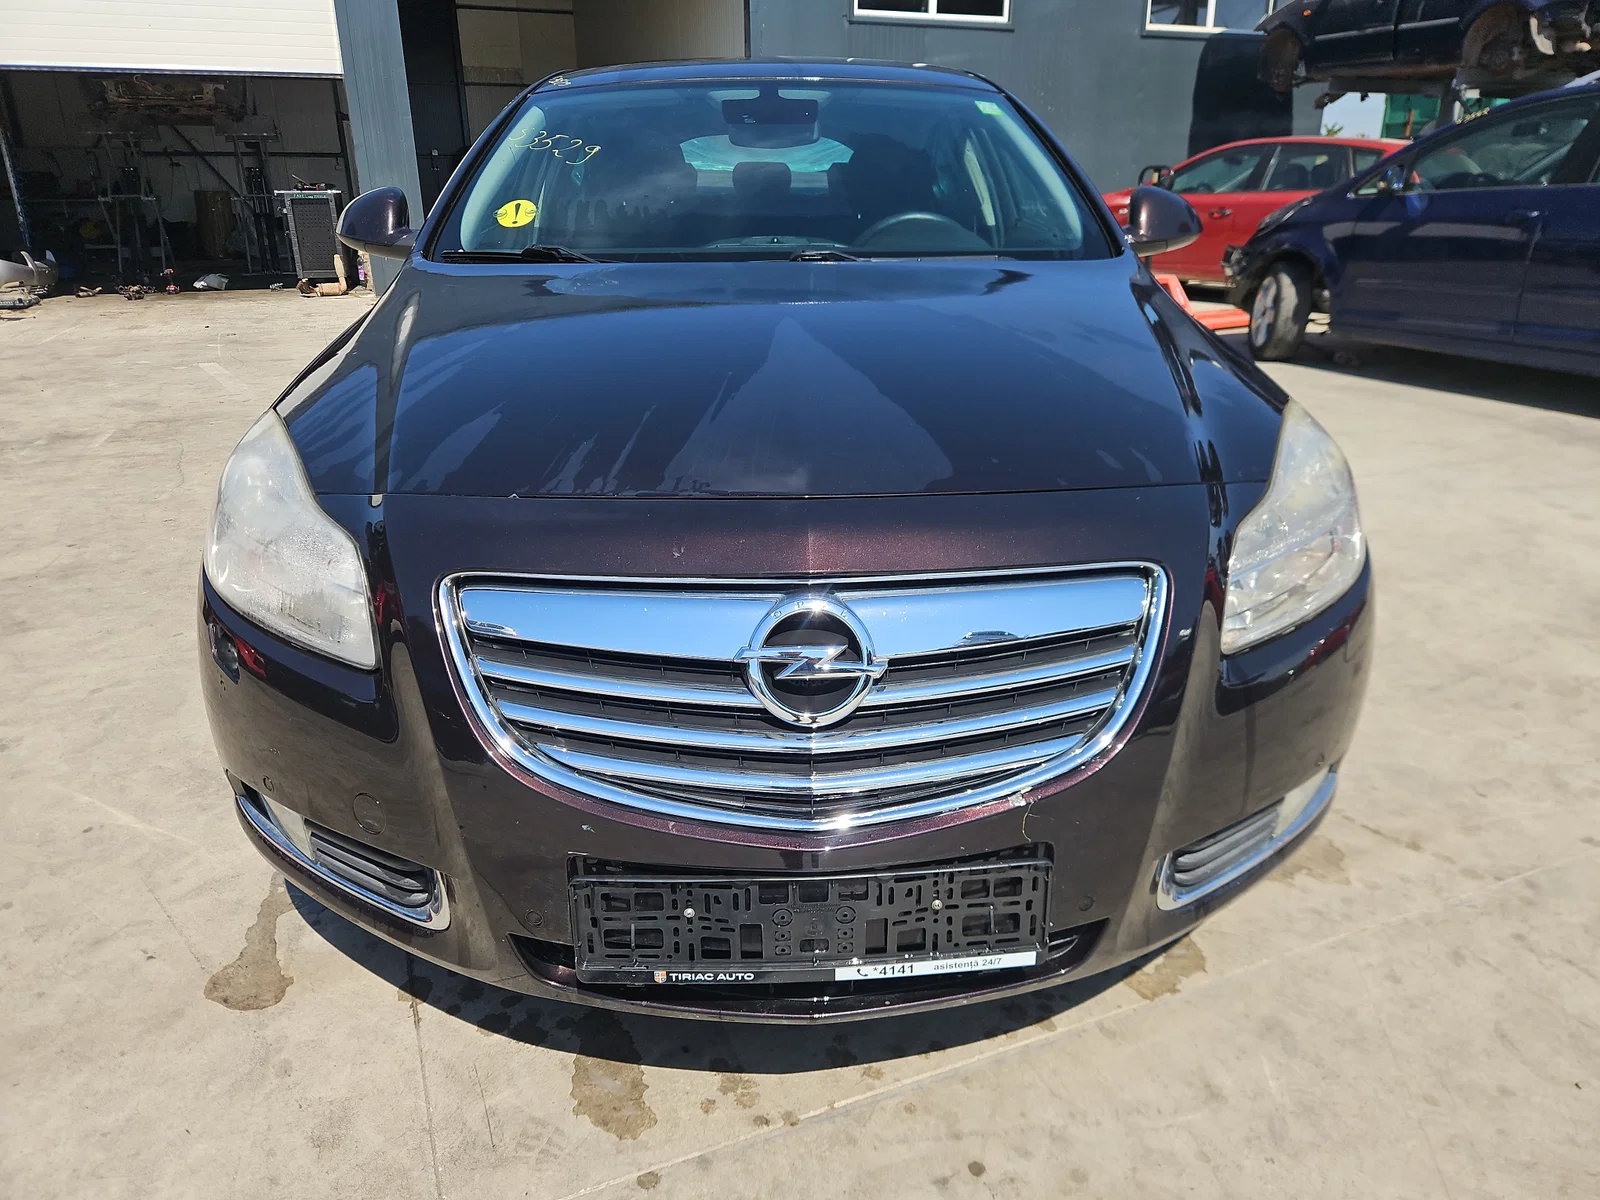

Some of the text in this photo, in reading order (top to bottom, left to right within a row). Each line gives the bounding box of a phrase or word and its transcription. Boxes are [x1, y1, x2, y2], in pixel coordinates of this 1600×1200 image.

[771, 598, 850, 621] OPL
[982, 958, 1002, 966] 24/7
[669, 973, 714, 982] TIRIAC
